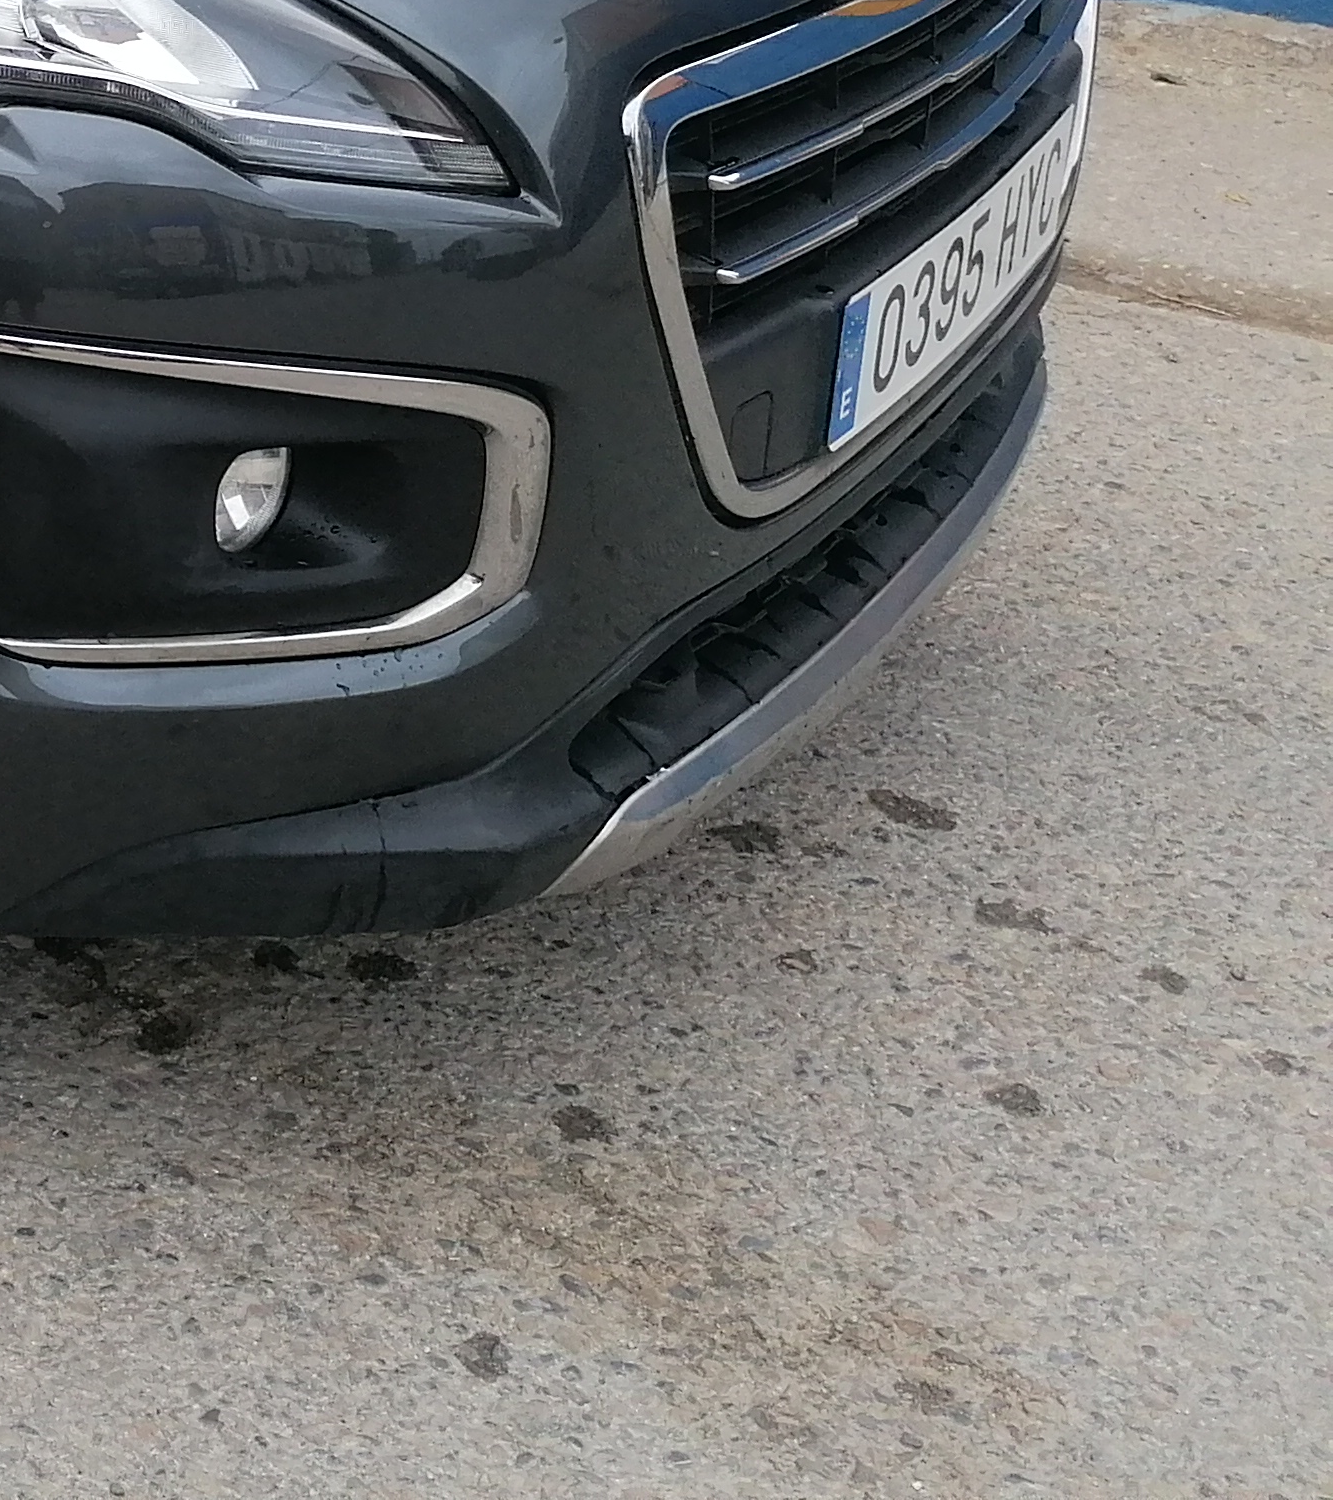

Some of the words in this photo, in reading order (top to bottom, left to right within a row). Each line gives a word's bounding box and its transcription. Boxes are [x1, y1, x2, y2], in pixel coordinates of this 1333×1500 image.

[873, 207, 991, 393] 0395
[995, 137, 1062, 288] HYC
[840, 386, 852, 420] E
